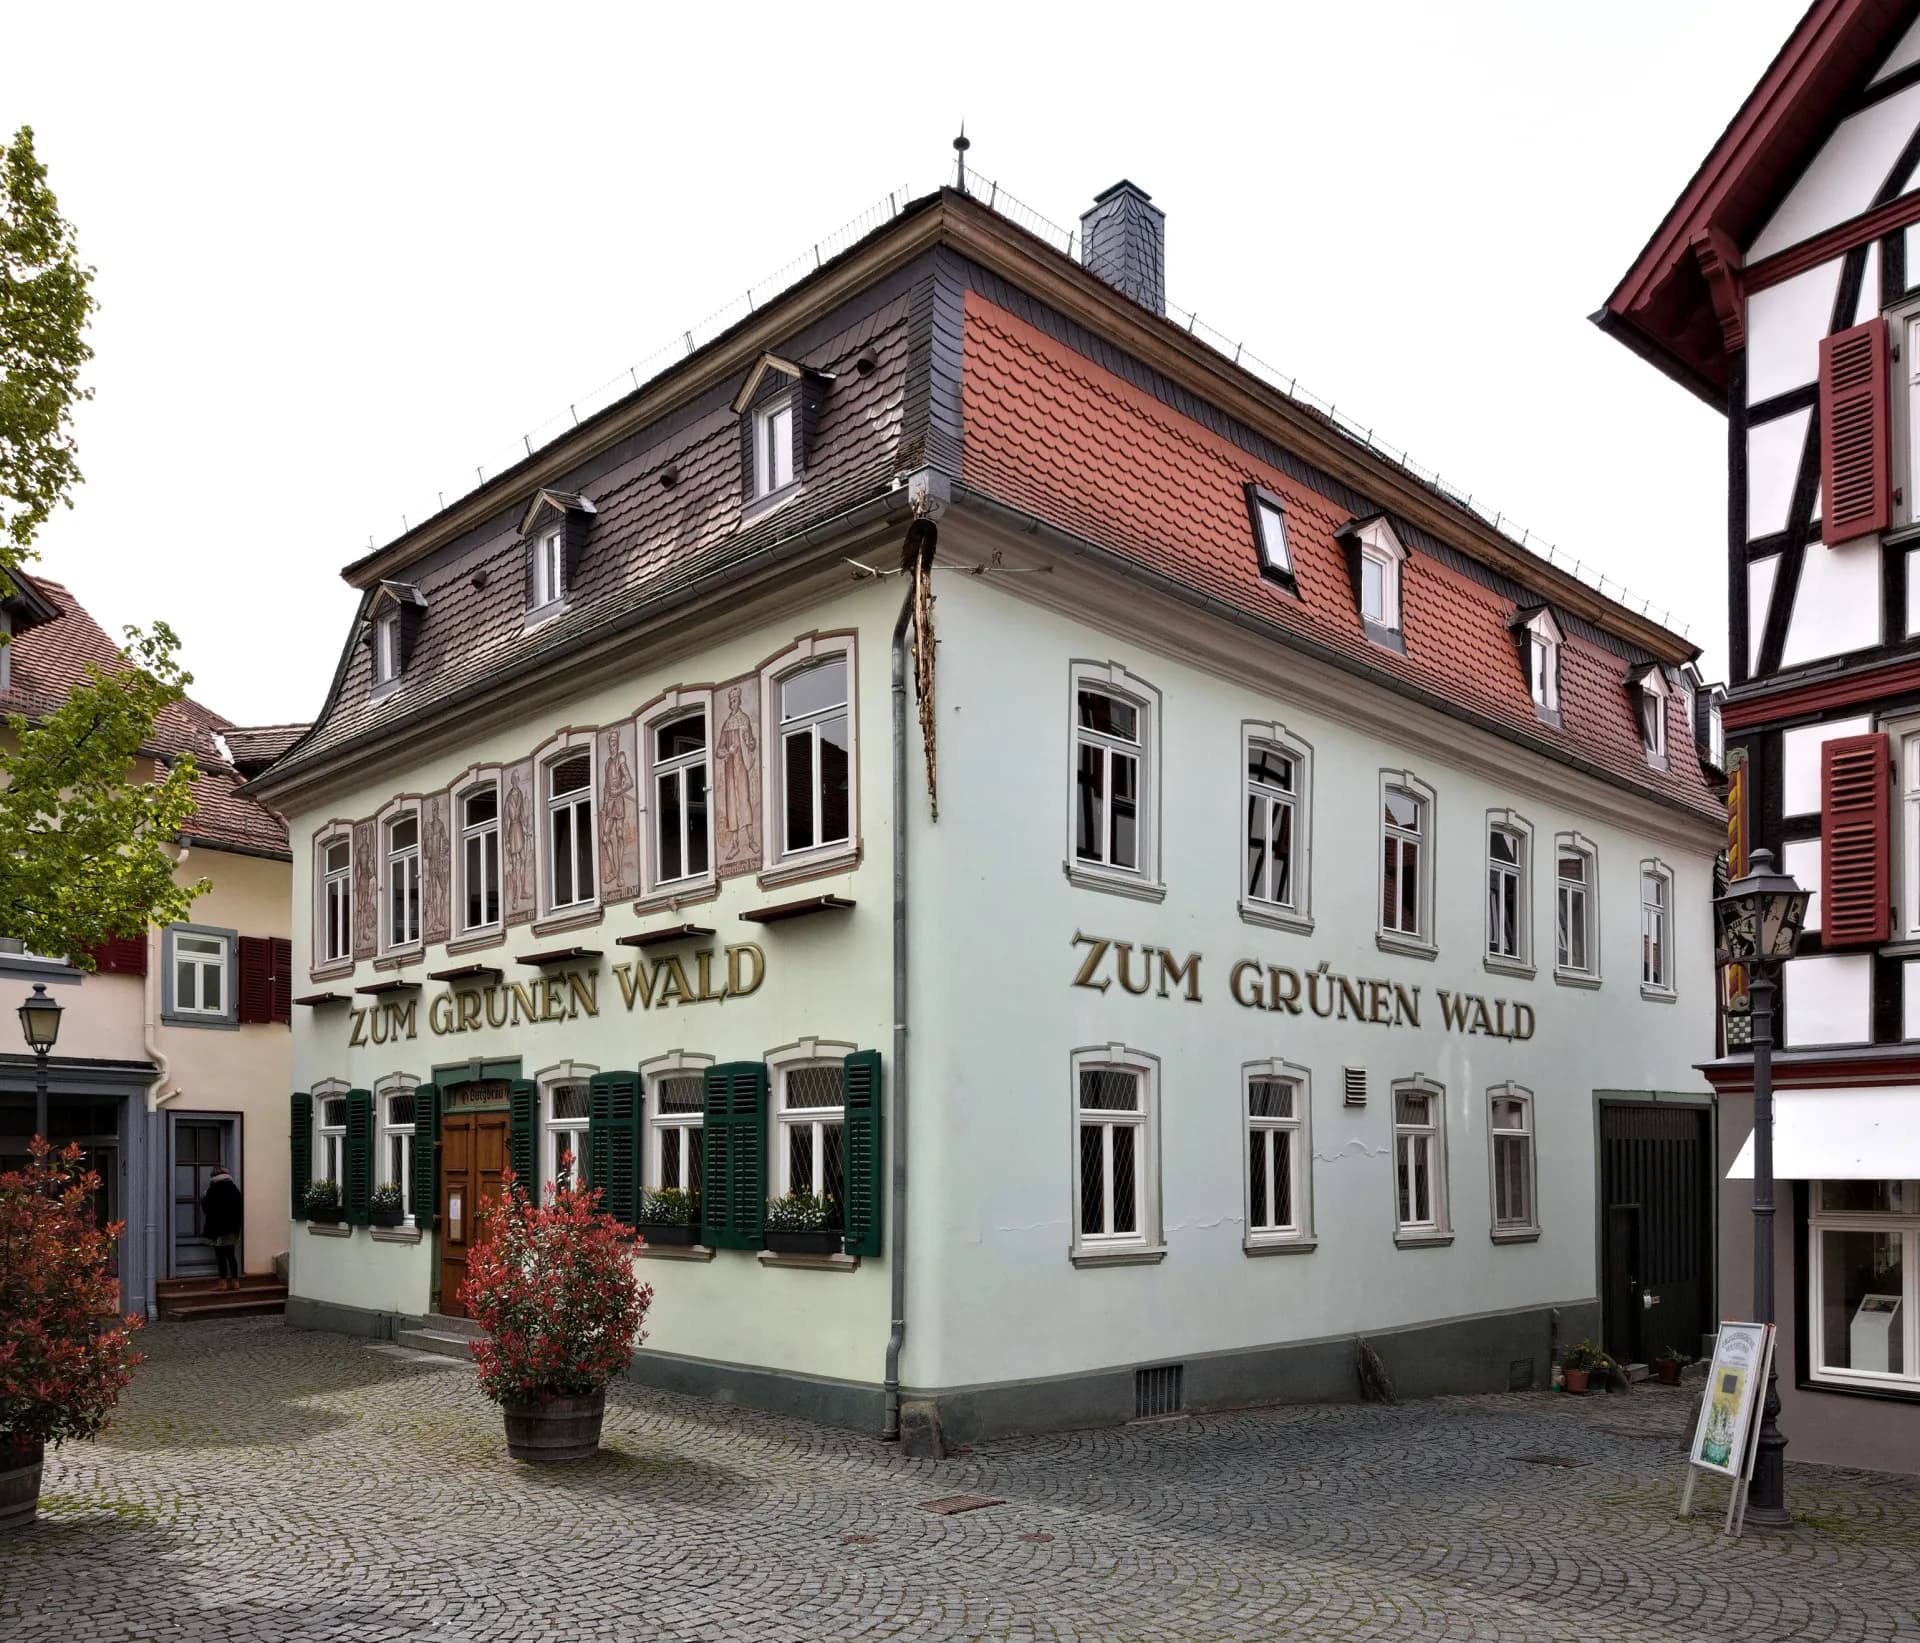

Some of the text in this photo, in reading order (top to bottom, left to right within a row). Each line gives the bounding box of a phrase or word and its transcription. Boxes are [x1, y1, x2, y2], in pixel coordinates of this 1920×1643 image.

[349, 1000, 418, 1048] ZUM
[612, 943, 767, 1010] WALD
[1070, 928, 1536, 1043] ZUM GRÜNEN WALD
